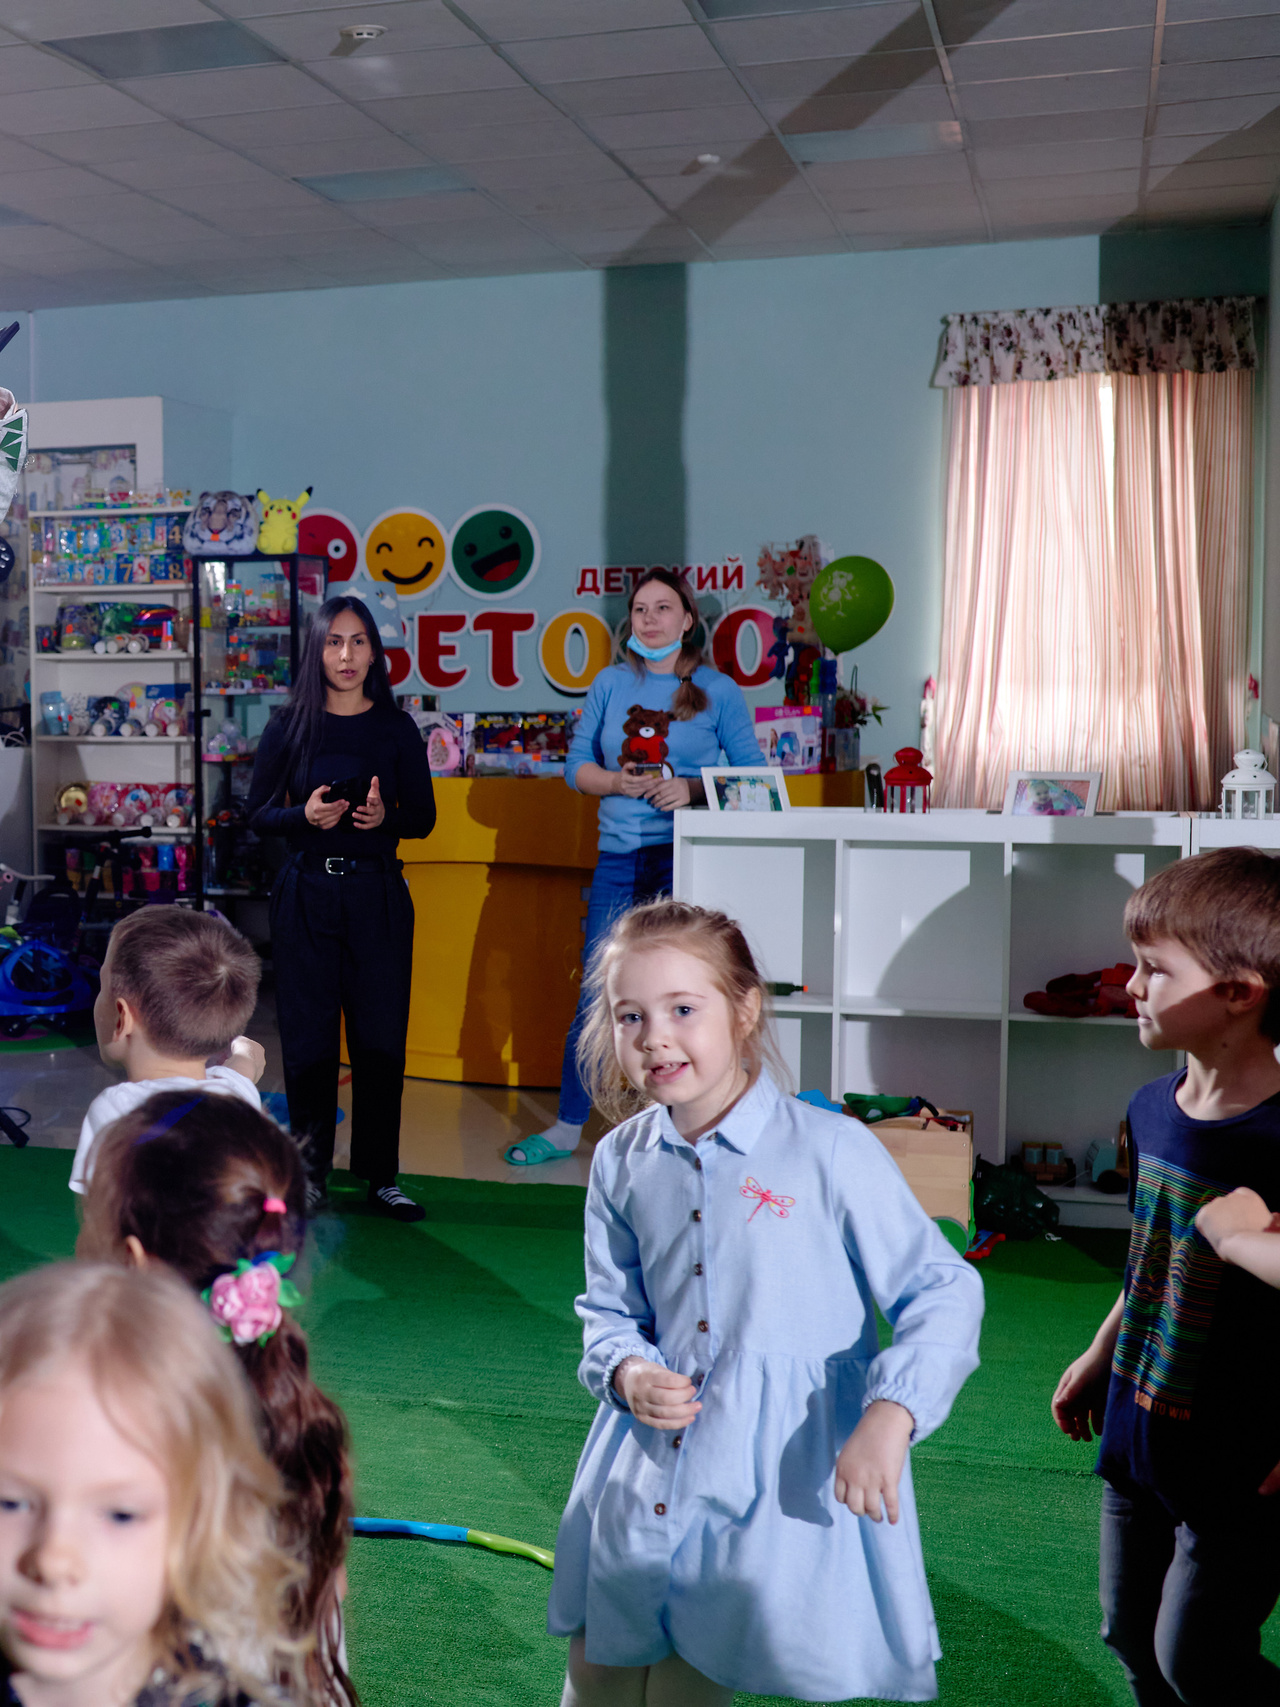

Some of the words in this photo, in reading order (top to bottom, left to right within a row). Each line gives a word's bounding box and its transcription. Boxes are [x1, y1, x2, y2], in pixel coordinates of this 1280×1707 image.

[576, 555, 744, 596] ДЕТИЙ
[1153, 1400, 1166, 1415] TO
[1168, 1405, 1191, 1421] WIN
